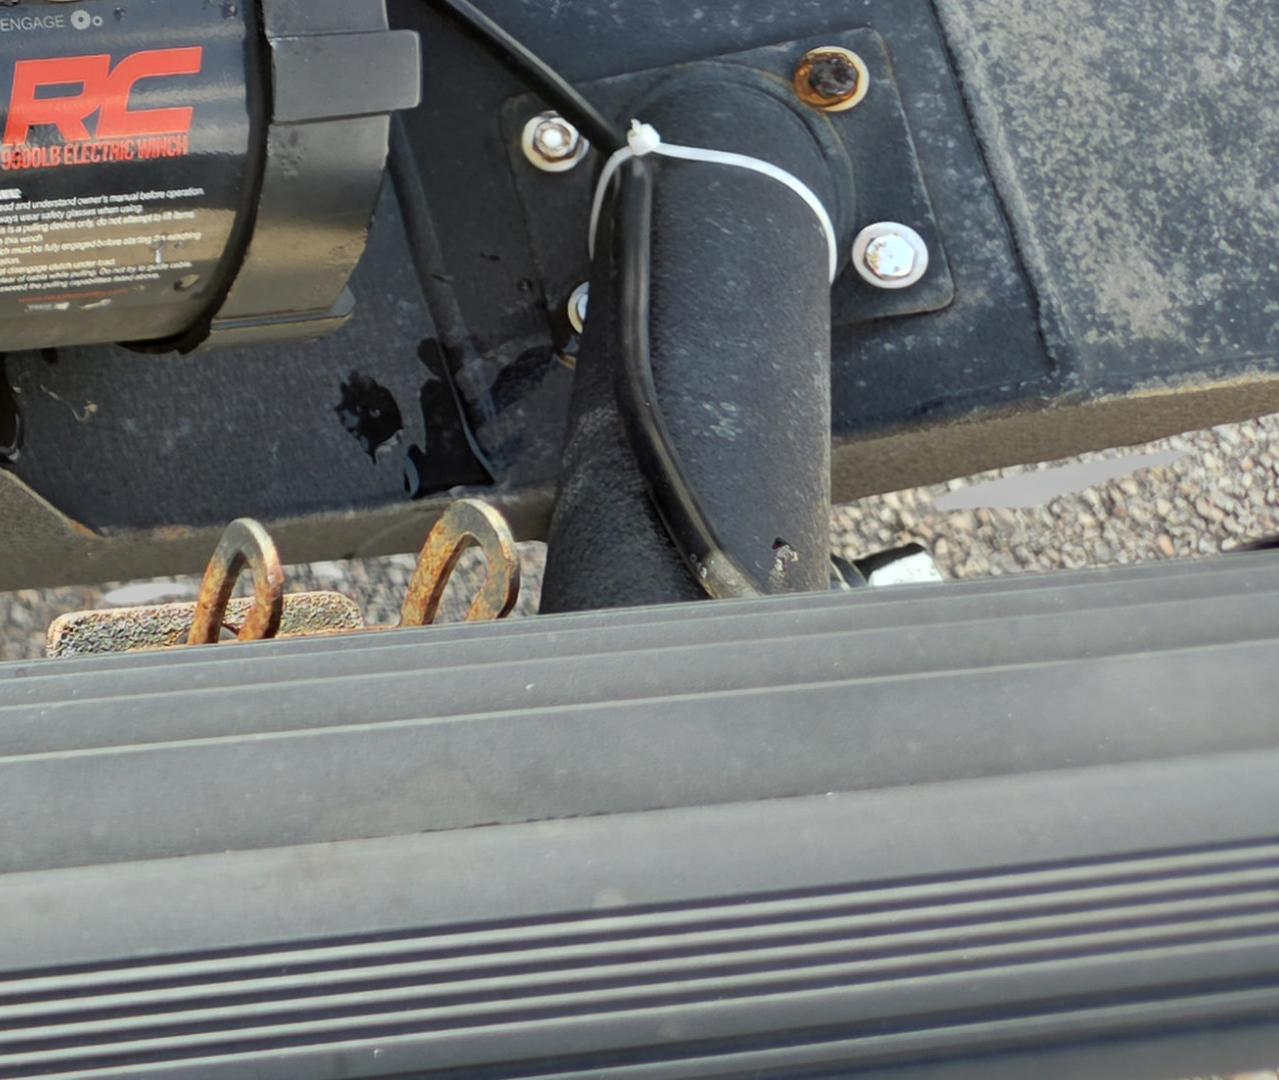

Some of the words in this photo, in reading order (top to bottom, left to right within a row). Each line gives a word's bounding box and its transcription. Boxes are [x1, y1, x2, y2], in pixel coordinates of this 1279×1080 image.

[2, 46, 203, 145] RC
[1, 145, 61, 170] 9500LB
[63, 139, 135, 166] ELECTRIC
[137, 135, 189, 160] WINCH
[15, 200, 31, 210] and
[32, 197, 77, 209] understand
[109, 191, 139, 202] manual
[140, 190, 165, 201] before
[20, 213, 40, 222] wear
[41, 210, 64, 221] safety
[65, 208, 96, 220] glasses
[97, 205, 119, 215] when
[23, 223, 49, 234] pulling
[49, 220, 76, 231] device
[96, 217, 107, 227] do
[108, 216, 122, 225] not
